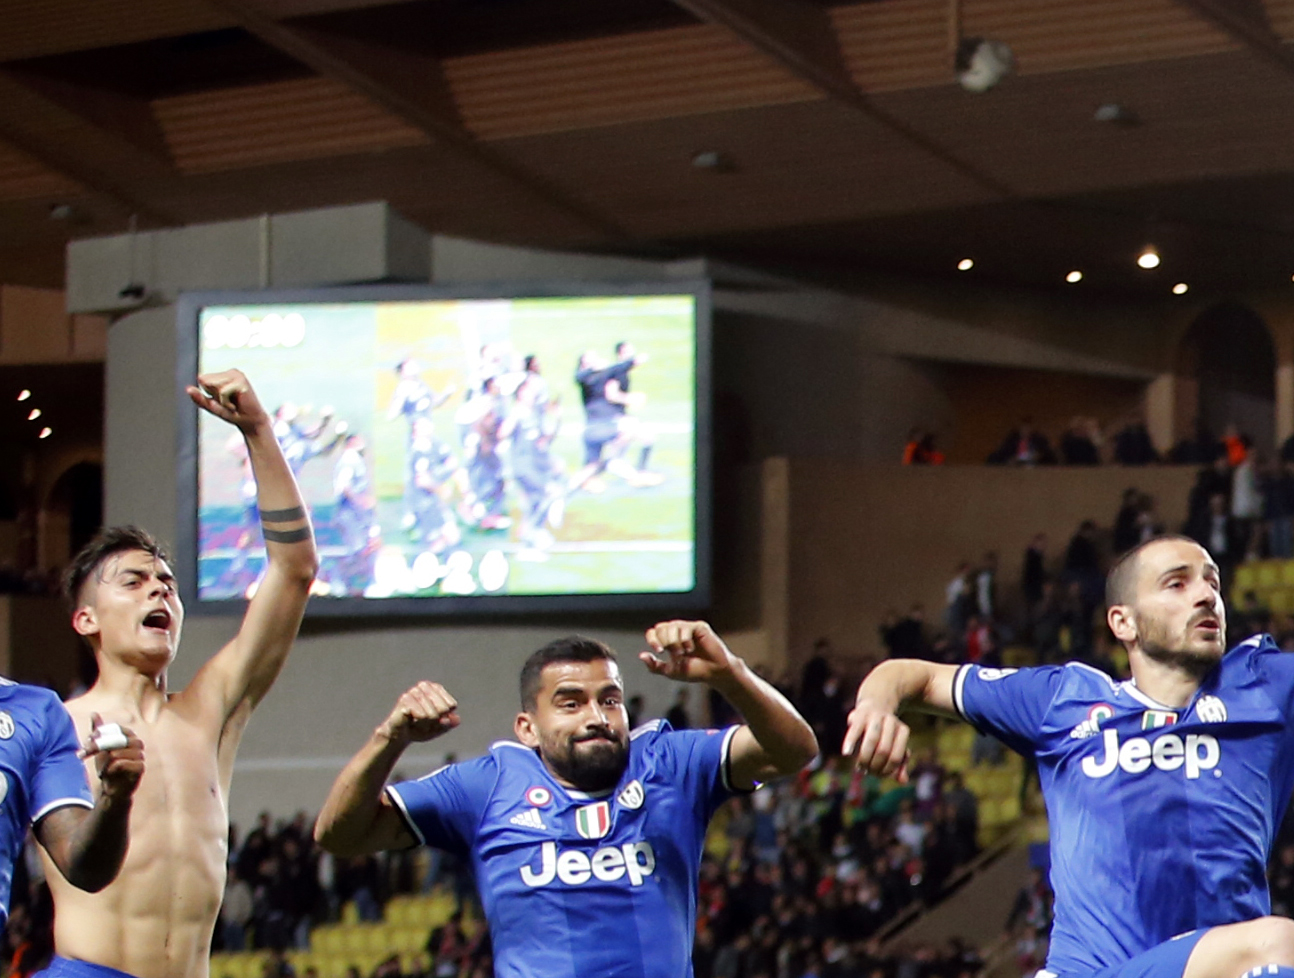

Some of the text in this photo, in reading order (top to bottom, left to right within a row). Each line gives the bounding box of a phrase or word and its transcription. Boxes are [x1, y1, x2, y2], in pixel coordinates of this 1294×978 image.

[1081, 728, 1221, 780] Jeep
[509, 815, 547, 831] adidas
[519, 840, 656, 888] Jeep
